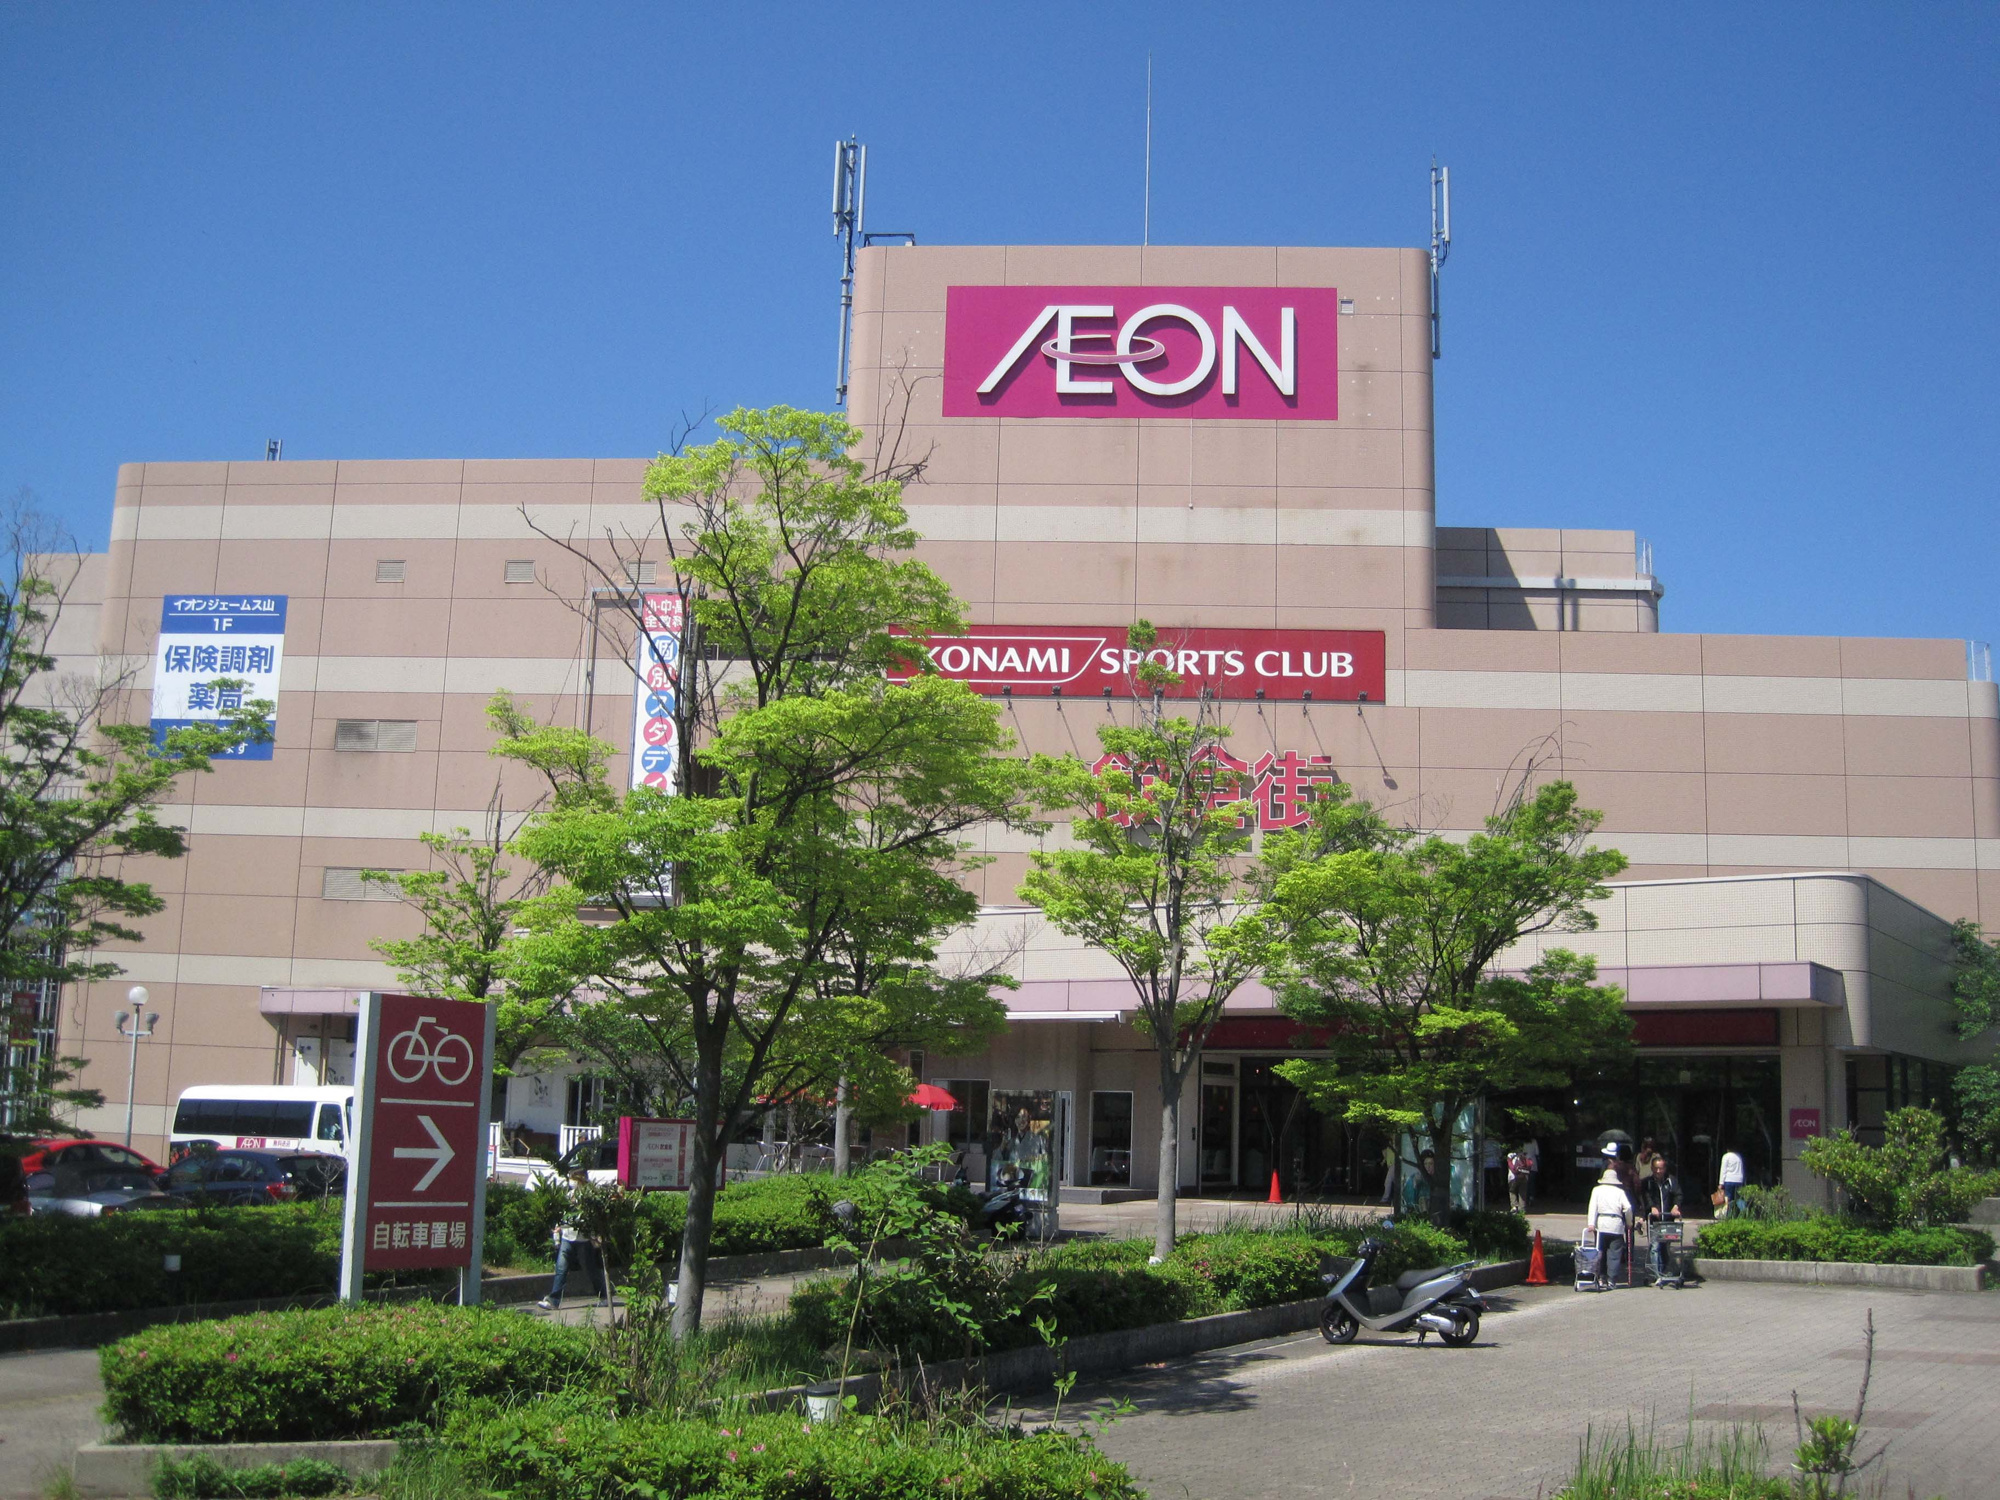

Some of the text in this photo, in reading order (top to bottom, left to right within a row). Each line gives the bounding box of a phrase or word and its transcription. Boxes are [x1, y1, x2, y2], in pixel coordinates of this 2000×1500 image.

[173, 598, 275, 612] イオンジェームス山
[213, 618, 233, 631] 1F
[165, 644, 275, 674] 保険調剤
[921, 646, 1353, 678] KONAMI SPORTS CLUB
[373, 1221, 467, 1250] 自転車置場
